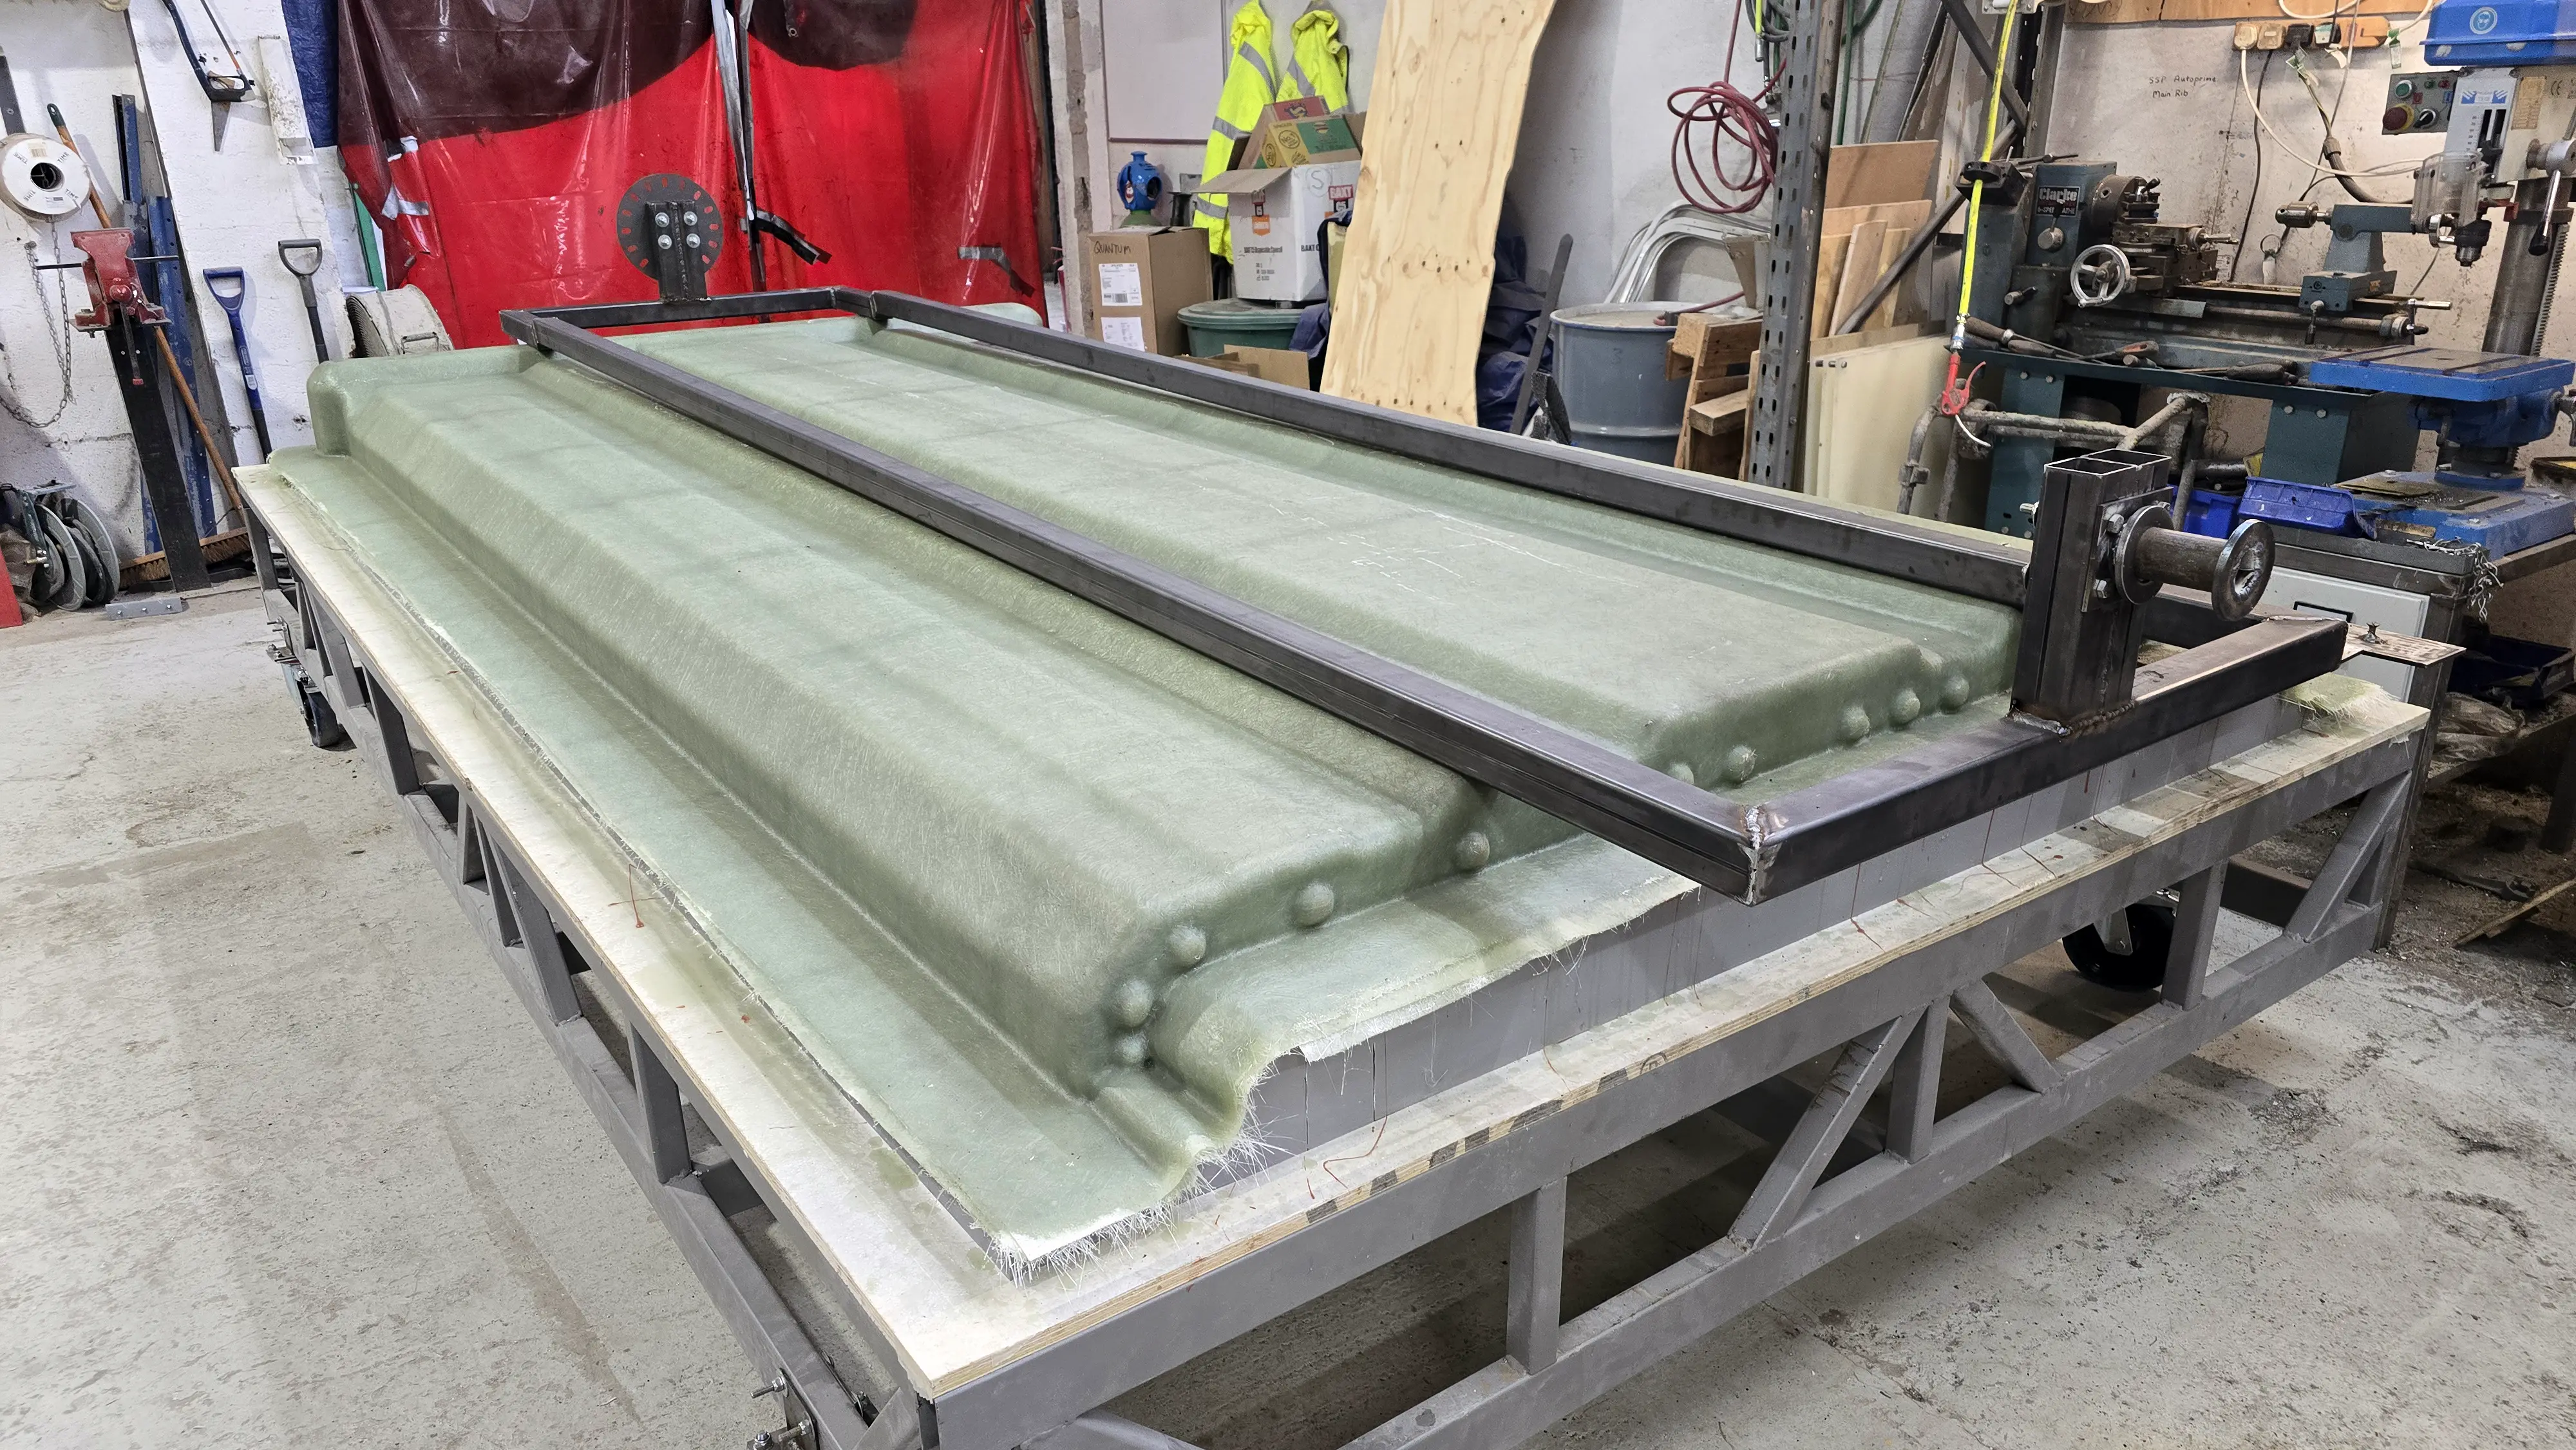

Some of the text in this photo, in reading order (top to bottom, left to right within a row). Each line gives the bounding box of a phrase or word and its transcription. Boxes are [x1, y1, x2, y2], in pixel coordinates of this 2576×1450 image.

[2174, 75, 2216, 86] Autoprime
[56, 151, 70, 163] TIME
[1311, 170, 1325, 190] S
[65, 189, 79, 200] TIME
[1330, 186, 1352, 200] BAXT
[2039, 188, 2078, 201] Clarke
[1094, 240, 1132, 254] QUANTUM
